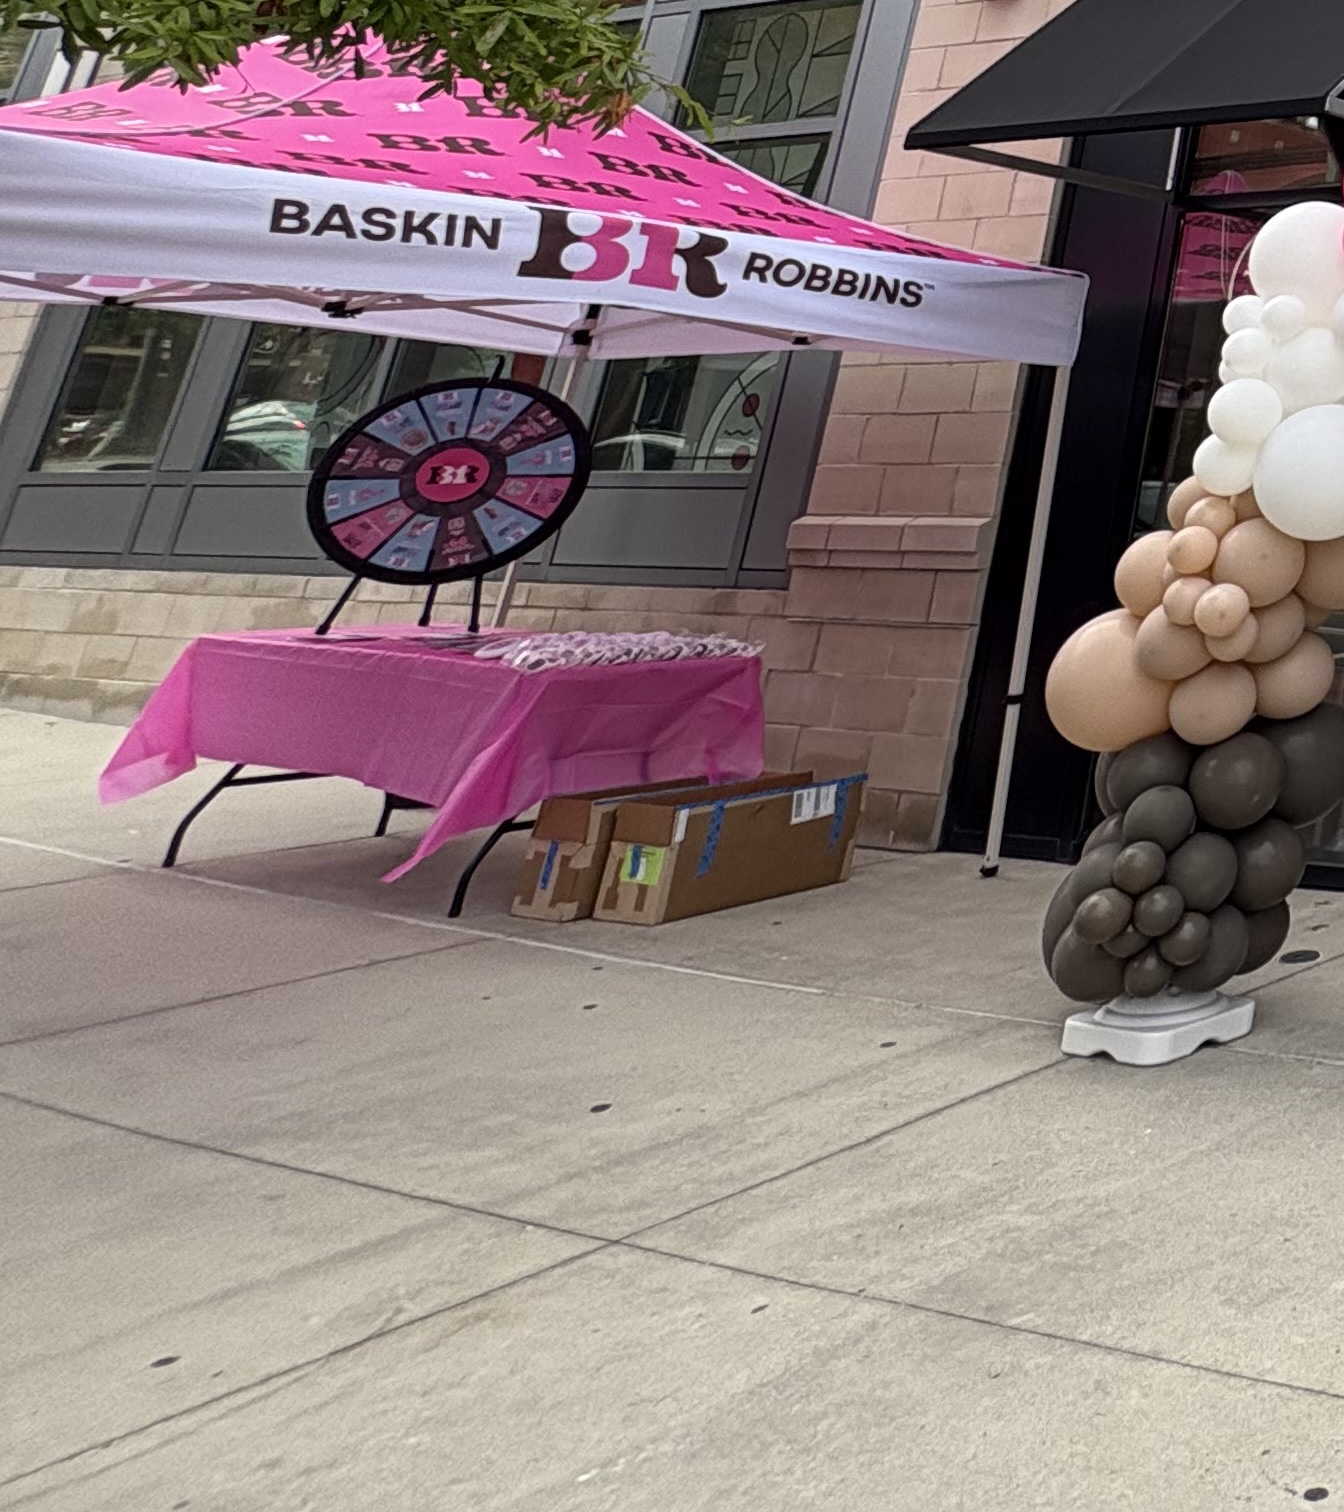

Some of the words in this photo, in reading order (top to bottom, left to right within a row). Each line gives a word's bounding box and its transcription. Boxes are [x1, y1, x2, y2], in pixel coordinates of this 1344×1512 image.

[269, 198, 502, 250] BASKIN
[517, 205, 728, 299] BR
[742, 253, 925, 309] ROBBINS
